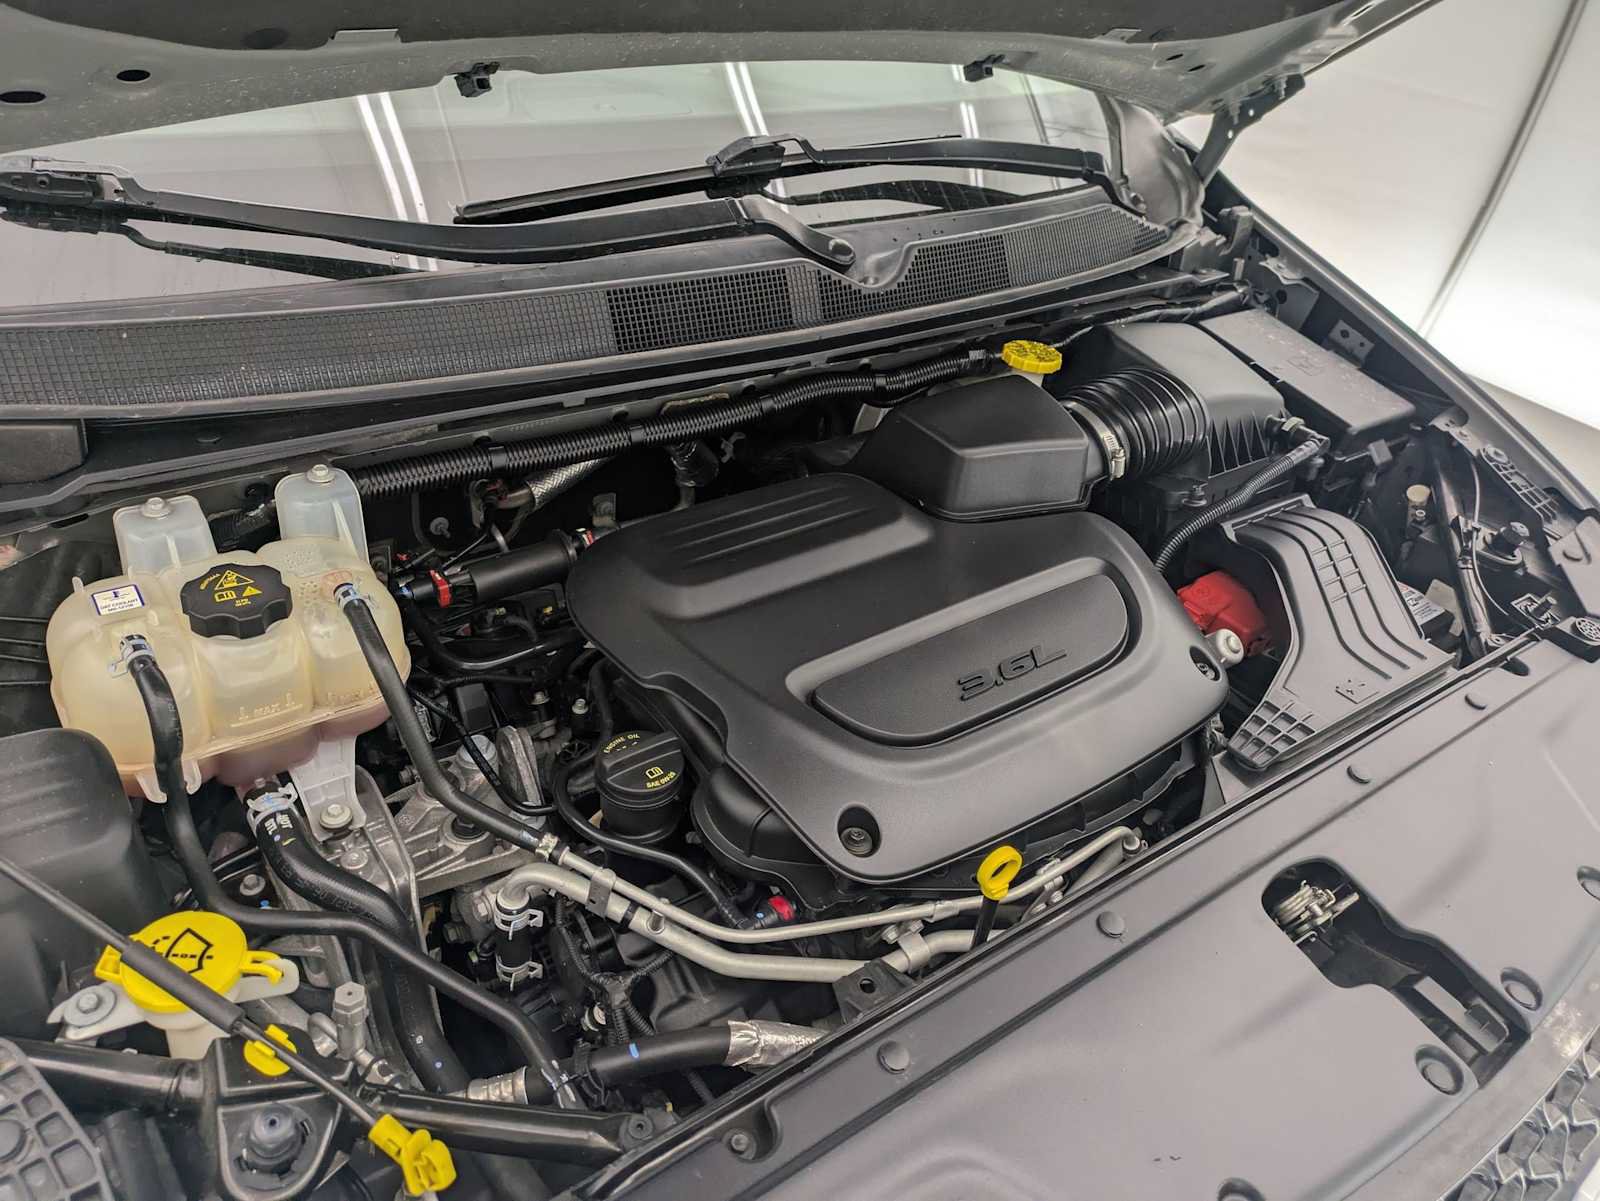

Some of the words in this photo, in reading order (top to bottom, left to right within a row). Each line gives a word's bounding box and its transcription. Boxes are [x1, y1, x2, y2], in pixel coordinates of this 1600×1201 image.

[957, 646, 1068, 701] 3.6L
[603, 736, 626, 753] ENGINE
[646, 780, 661, 789] SAE
